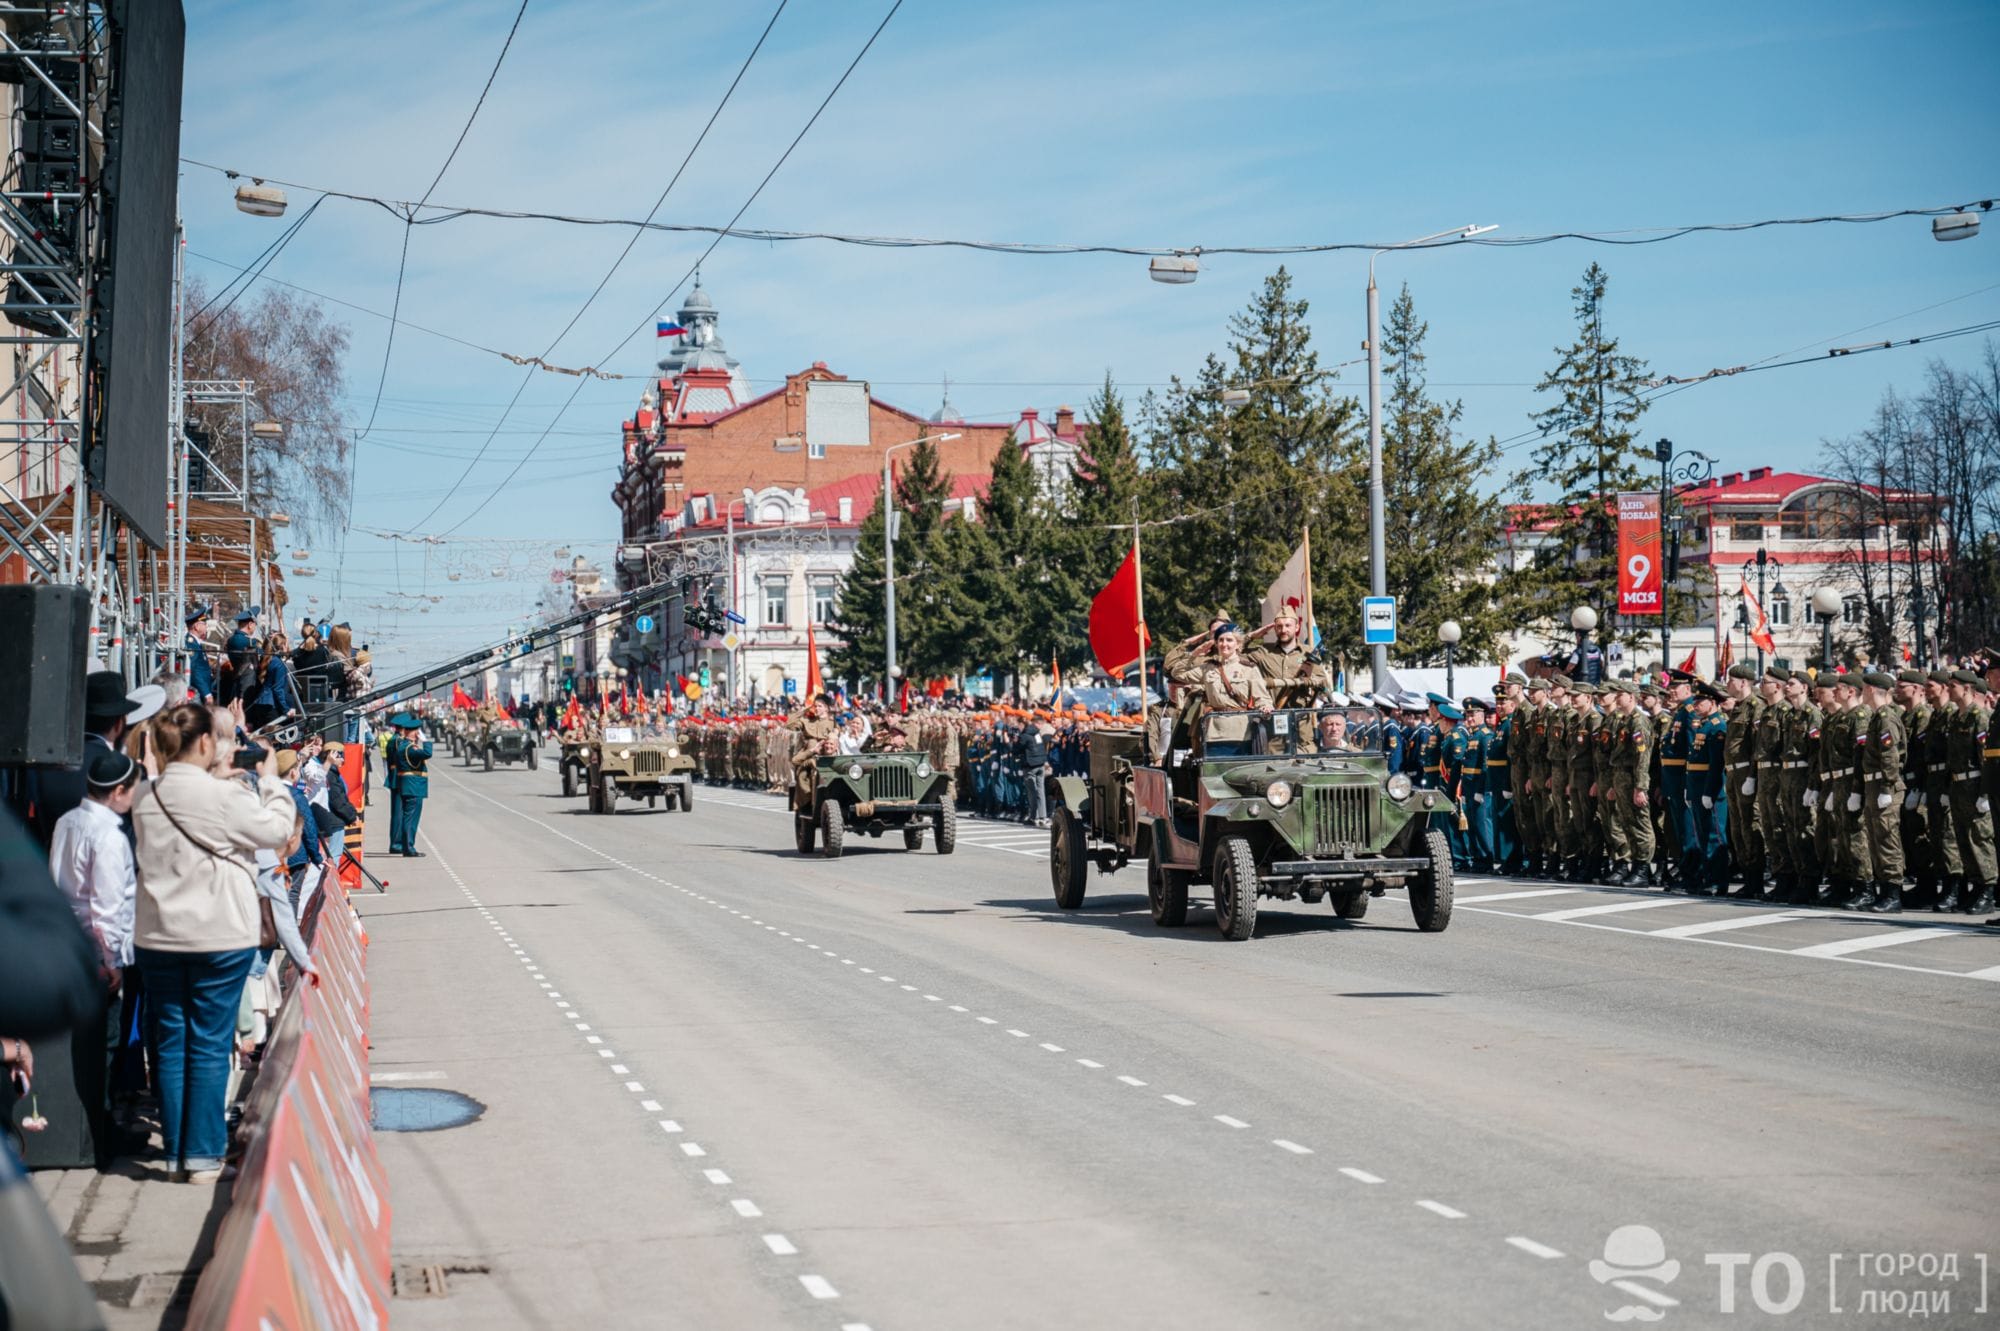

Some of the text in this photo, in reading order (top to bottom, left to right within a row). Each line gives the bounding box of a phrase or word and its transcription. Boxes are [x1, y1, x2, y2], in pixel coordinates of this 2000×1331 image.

[1620, 500, 1645, 511] ДЕНЬ
[1620, 511, 1657, 520] ПОБЕДЫ
[1628, 554, 1650, 589] 9
